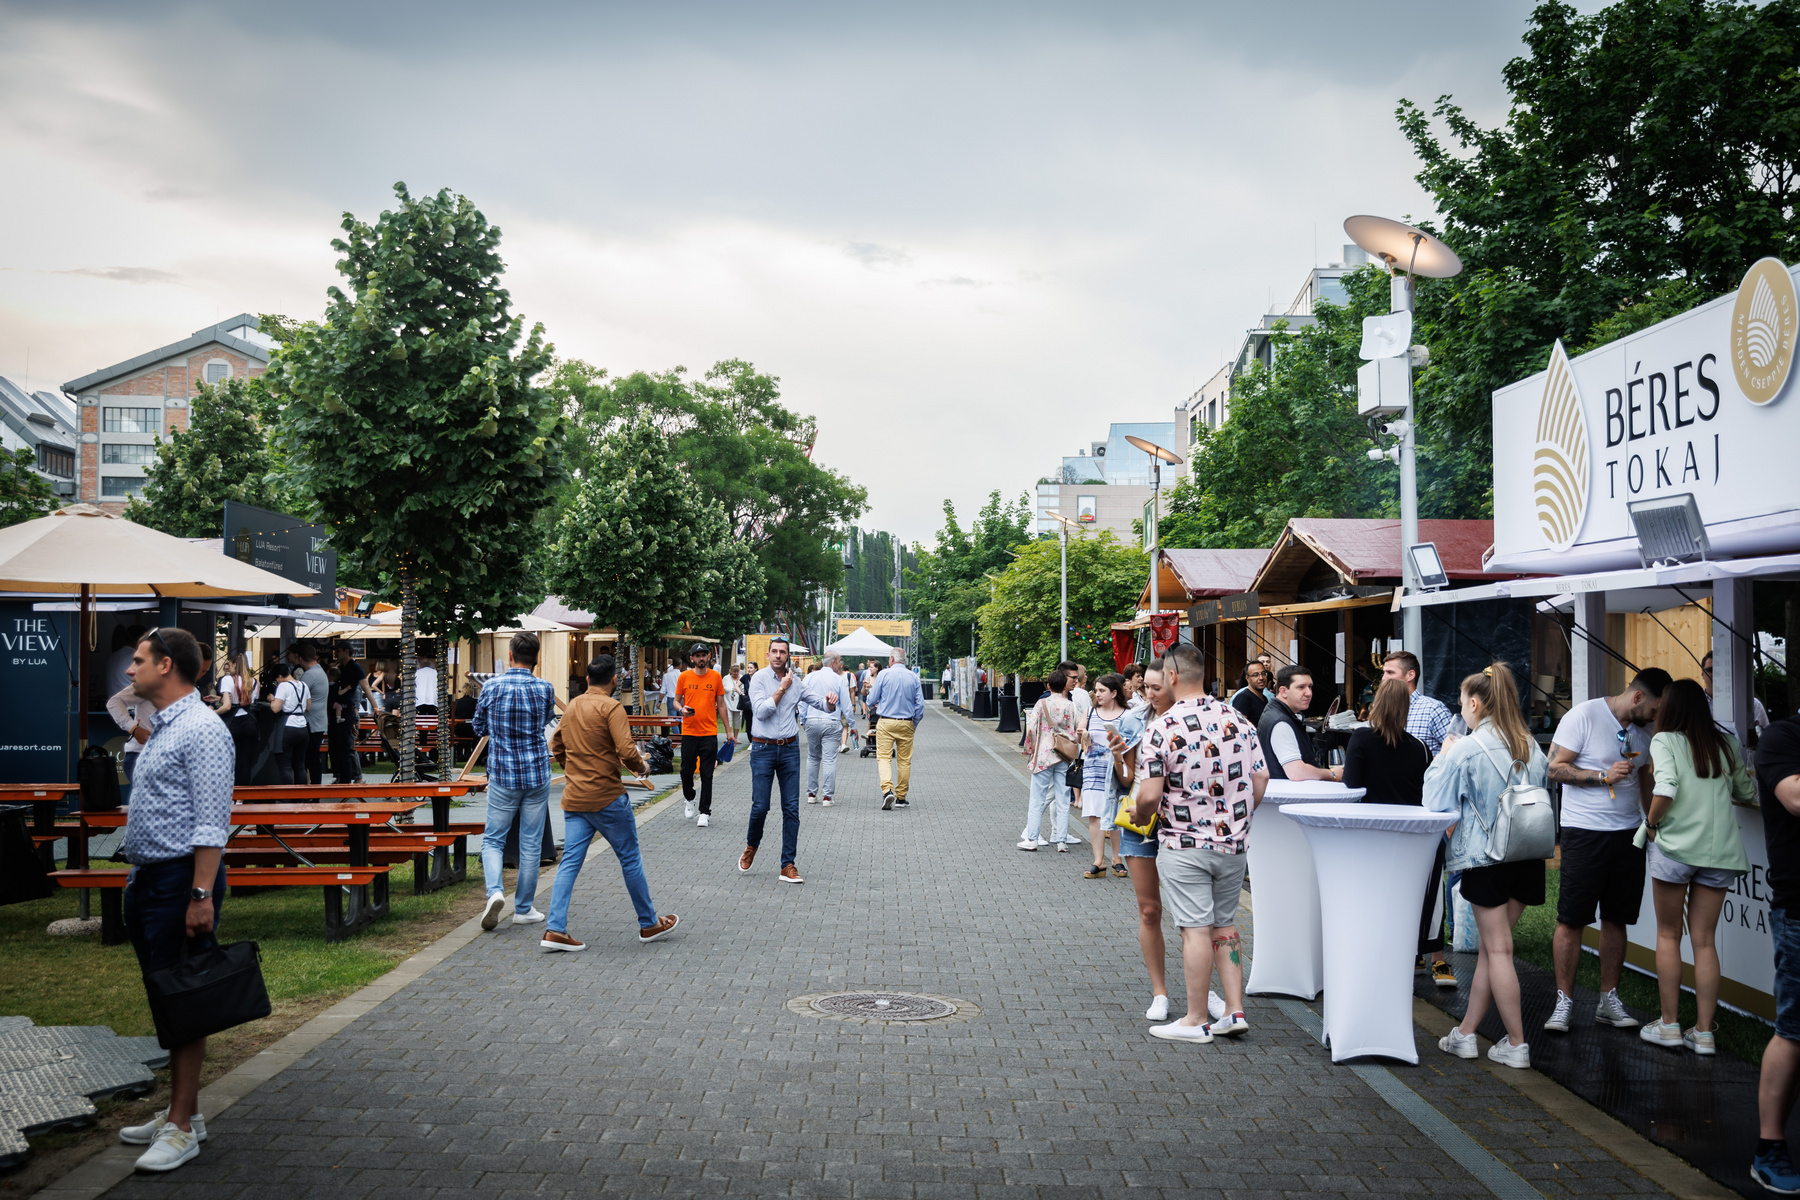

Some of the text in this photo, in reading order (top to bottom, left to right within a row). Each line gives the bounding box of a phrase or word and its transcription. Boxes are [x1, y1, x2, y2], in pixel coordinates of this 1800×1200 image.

[1736, 313, 1750, 379] MINDEN
[1605, 353, 1720, 448] BÉRES
[1606, 433, 1719, 499] TOKAJ
[255, 540, 265, 550] LUA
[306, 552, 328, 574] VIEW
[1581, 580, 1598, 590] TOKAJ
[14, 619, 47, 632] THE
[1, 633, 60, 651] VIEW
